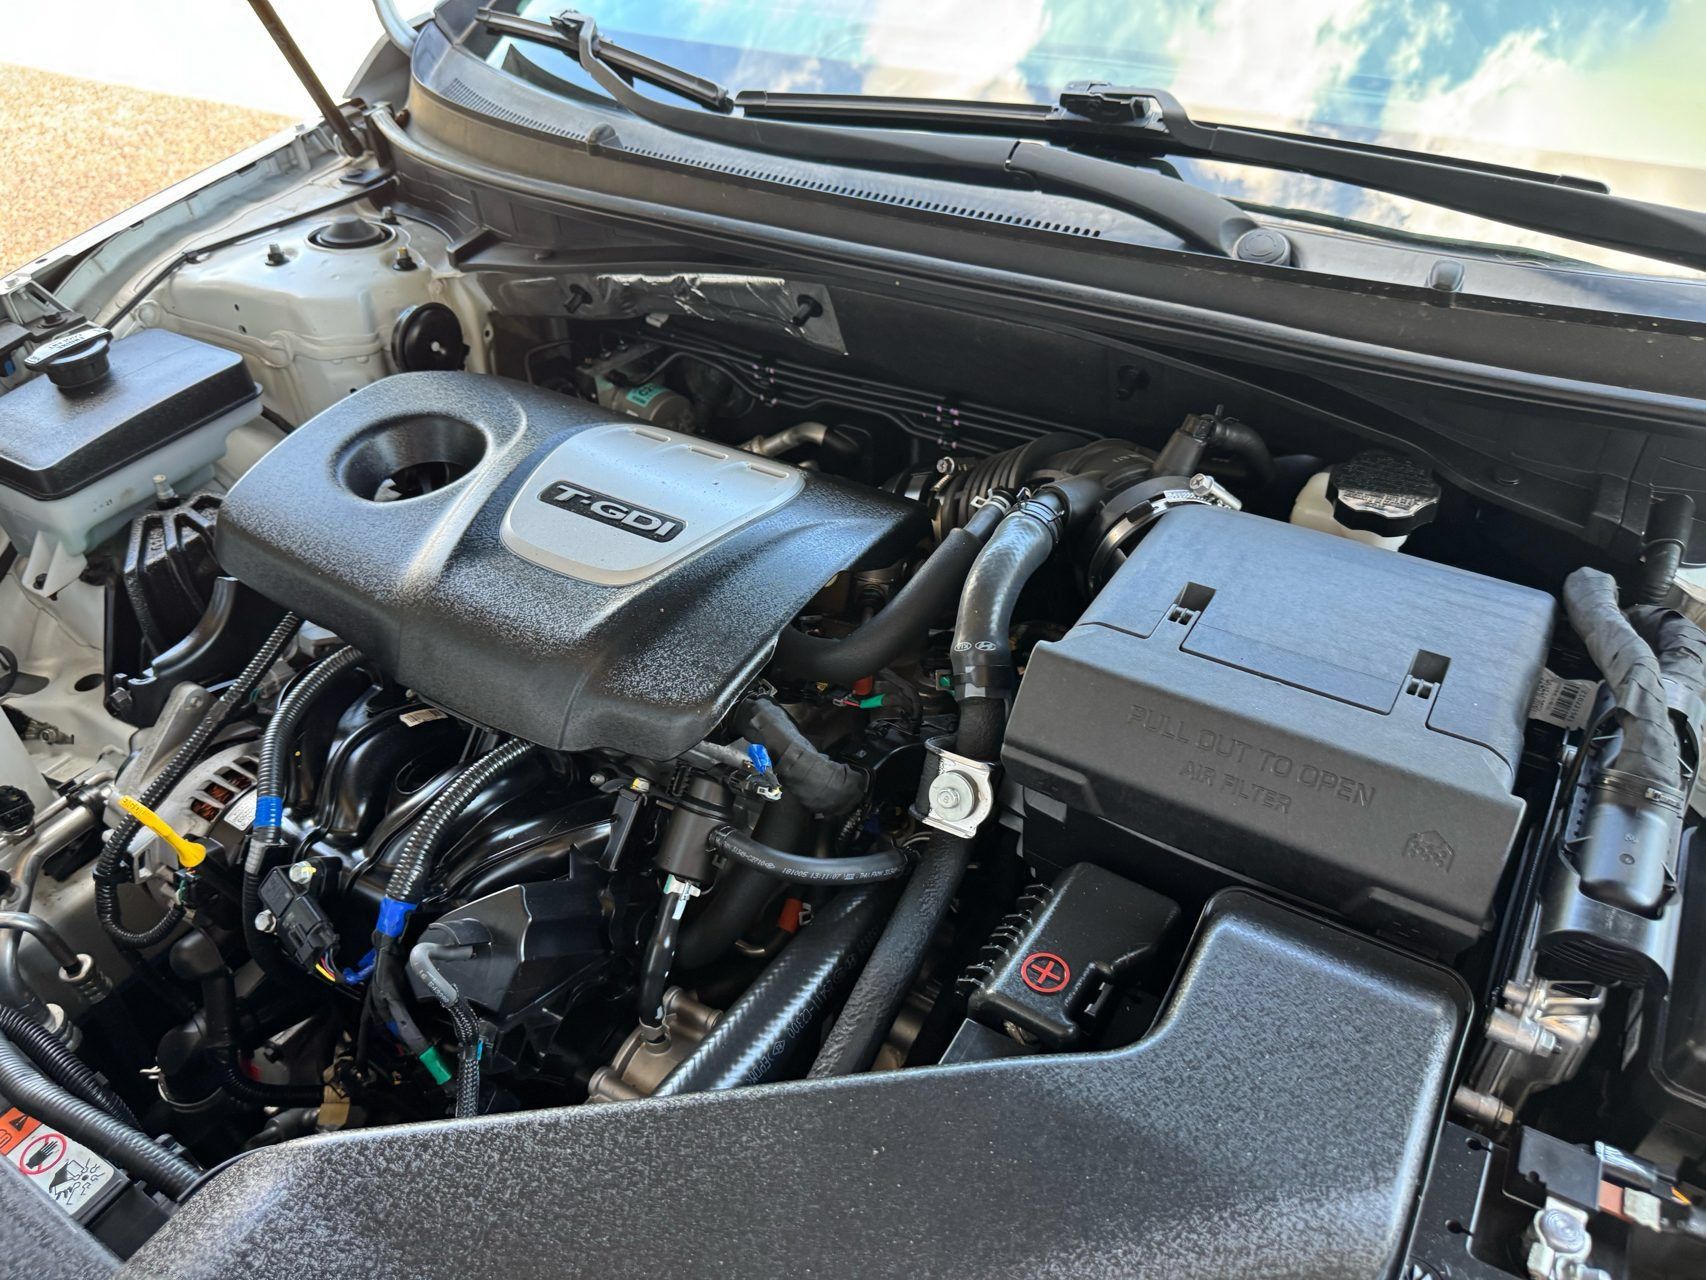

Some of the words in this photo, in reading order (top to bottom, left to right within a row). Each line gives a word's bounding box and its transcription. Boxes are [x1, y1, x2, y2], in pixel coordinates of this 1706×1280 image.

[1127, 703, 1190, 744] PULL
[1196, 729, 1254, 763] OUT
[1253, 748, 1294, 779] TO
[1297, 764, 1376, 808] OPEN
[1179, 760, 1217, 787] AIR
[1219, 773, 1293, 814] FILTER
